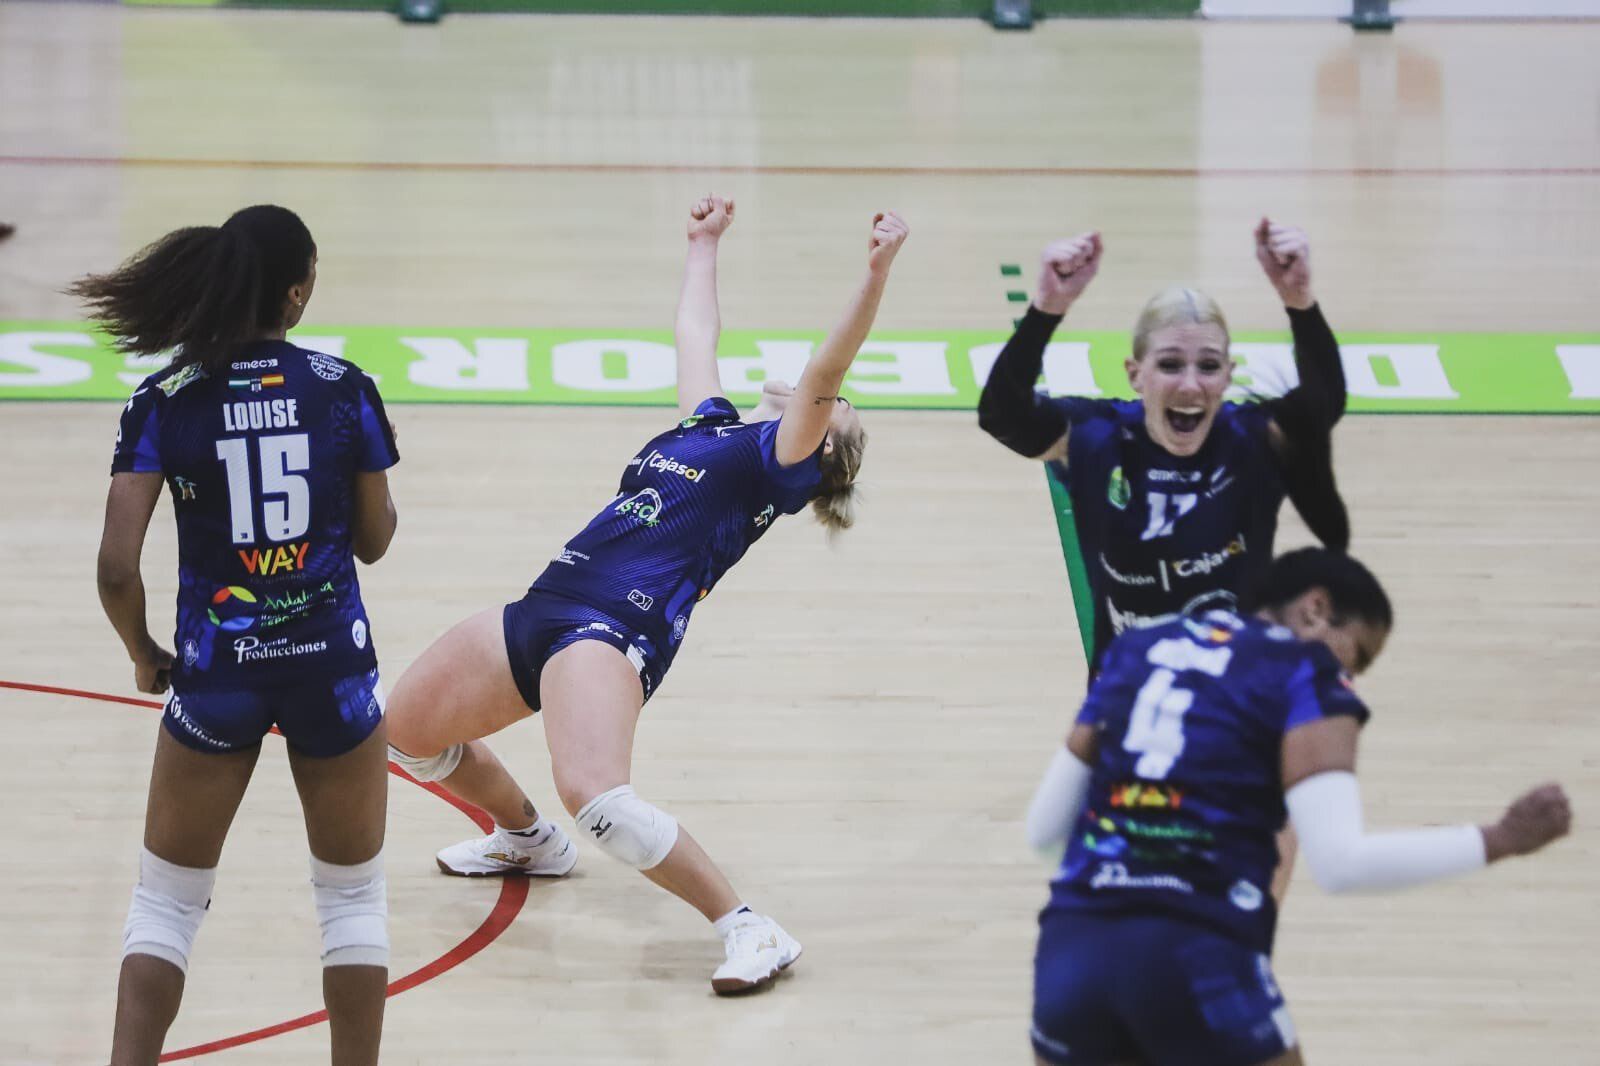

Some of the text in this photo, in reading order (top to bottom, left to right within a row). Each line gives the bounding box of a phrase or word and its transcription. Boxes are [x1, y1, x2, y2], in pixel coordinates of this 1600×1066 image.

[223, 398, 299, 432] LOUISE
[648, 448, 706, 483] Cajasol
[215, 433, 310, 544] 15
[1140, 492, 1198, 541] 17
[238, 542, 309, 576] WAY
[234, 636, 327, 663] Producciones
